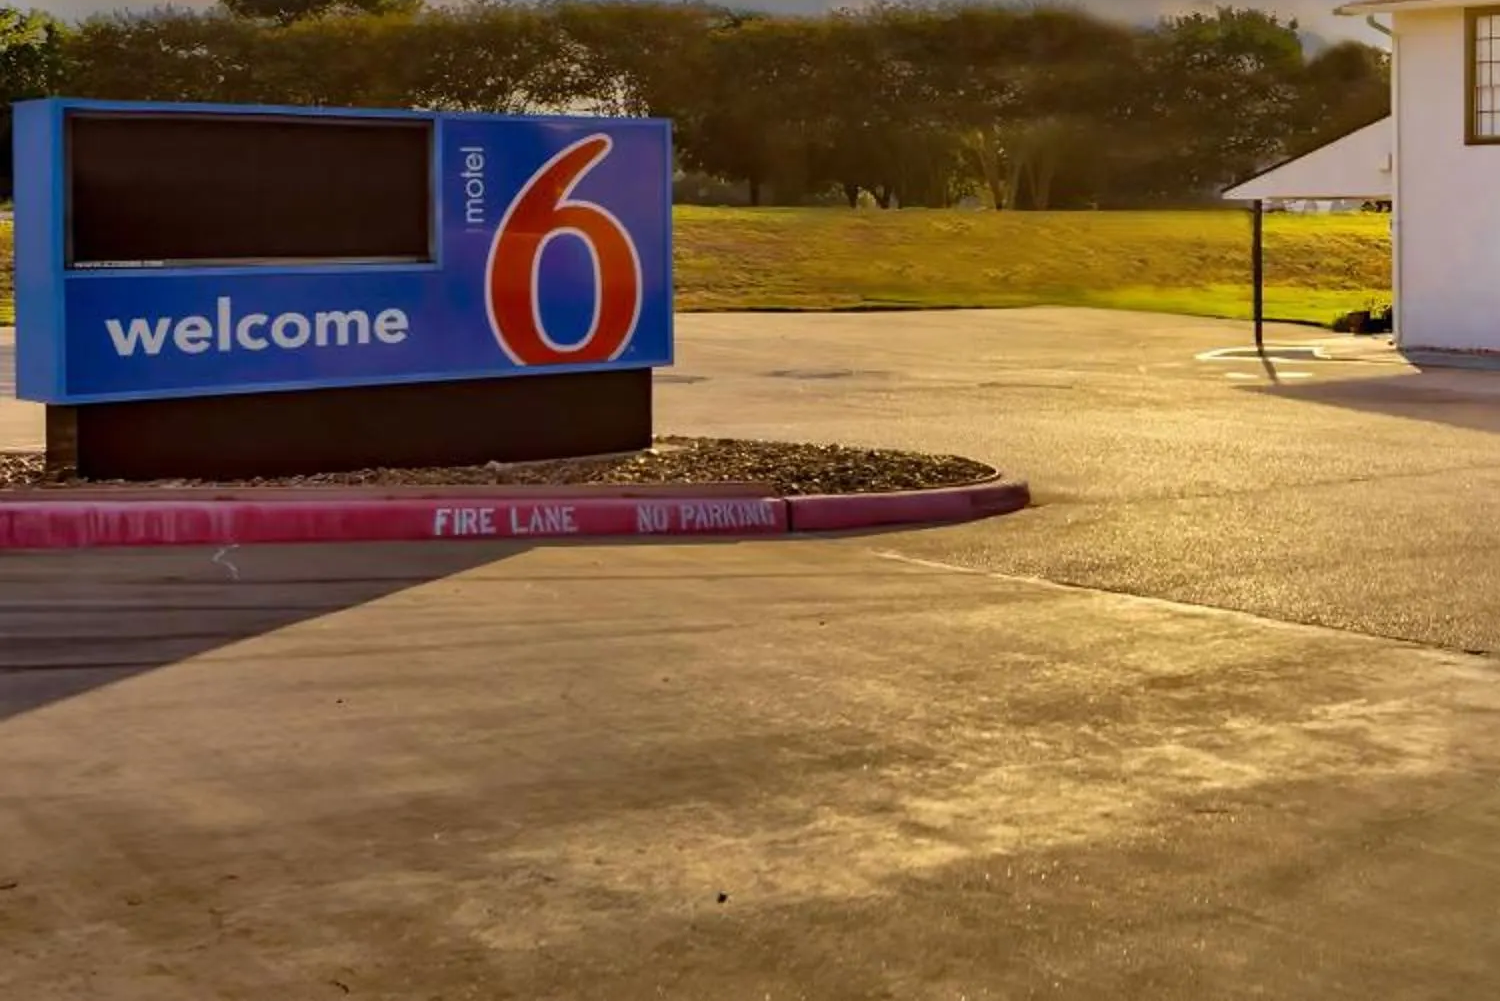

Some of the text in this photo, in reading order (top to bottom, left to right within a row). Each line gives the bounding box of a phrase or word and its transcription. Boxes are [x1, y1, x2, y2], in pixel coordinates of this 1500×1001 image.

[460, 132, 643, 367] motel 6
[105, 296, 409, 356] welcome
[434, 500, 776, 536] FIRE LANE NO PARKING
